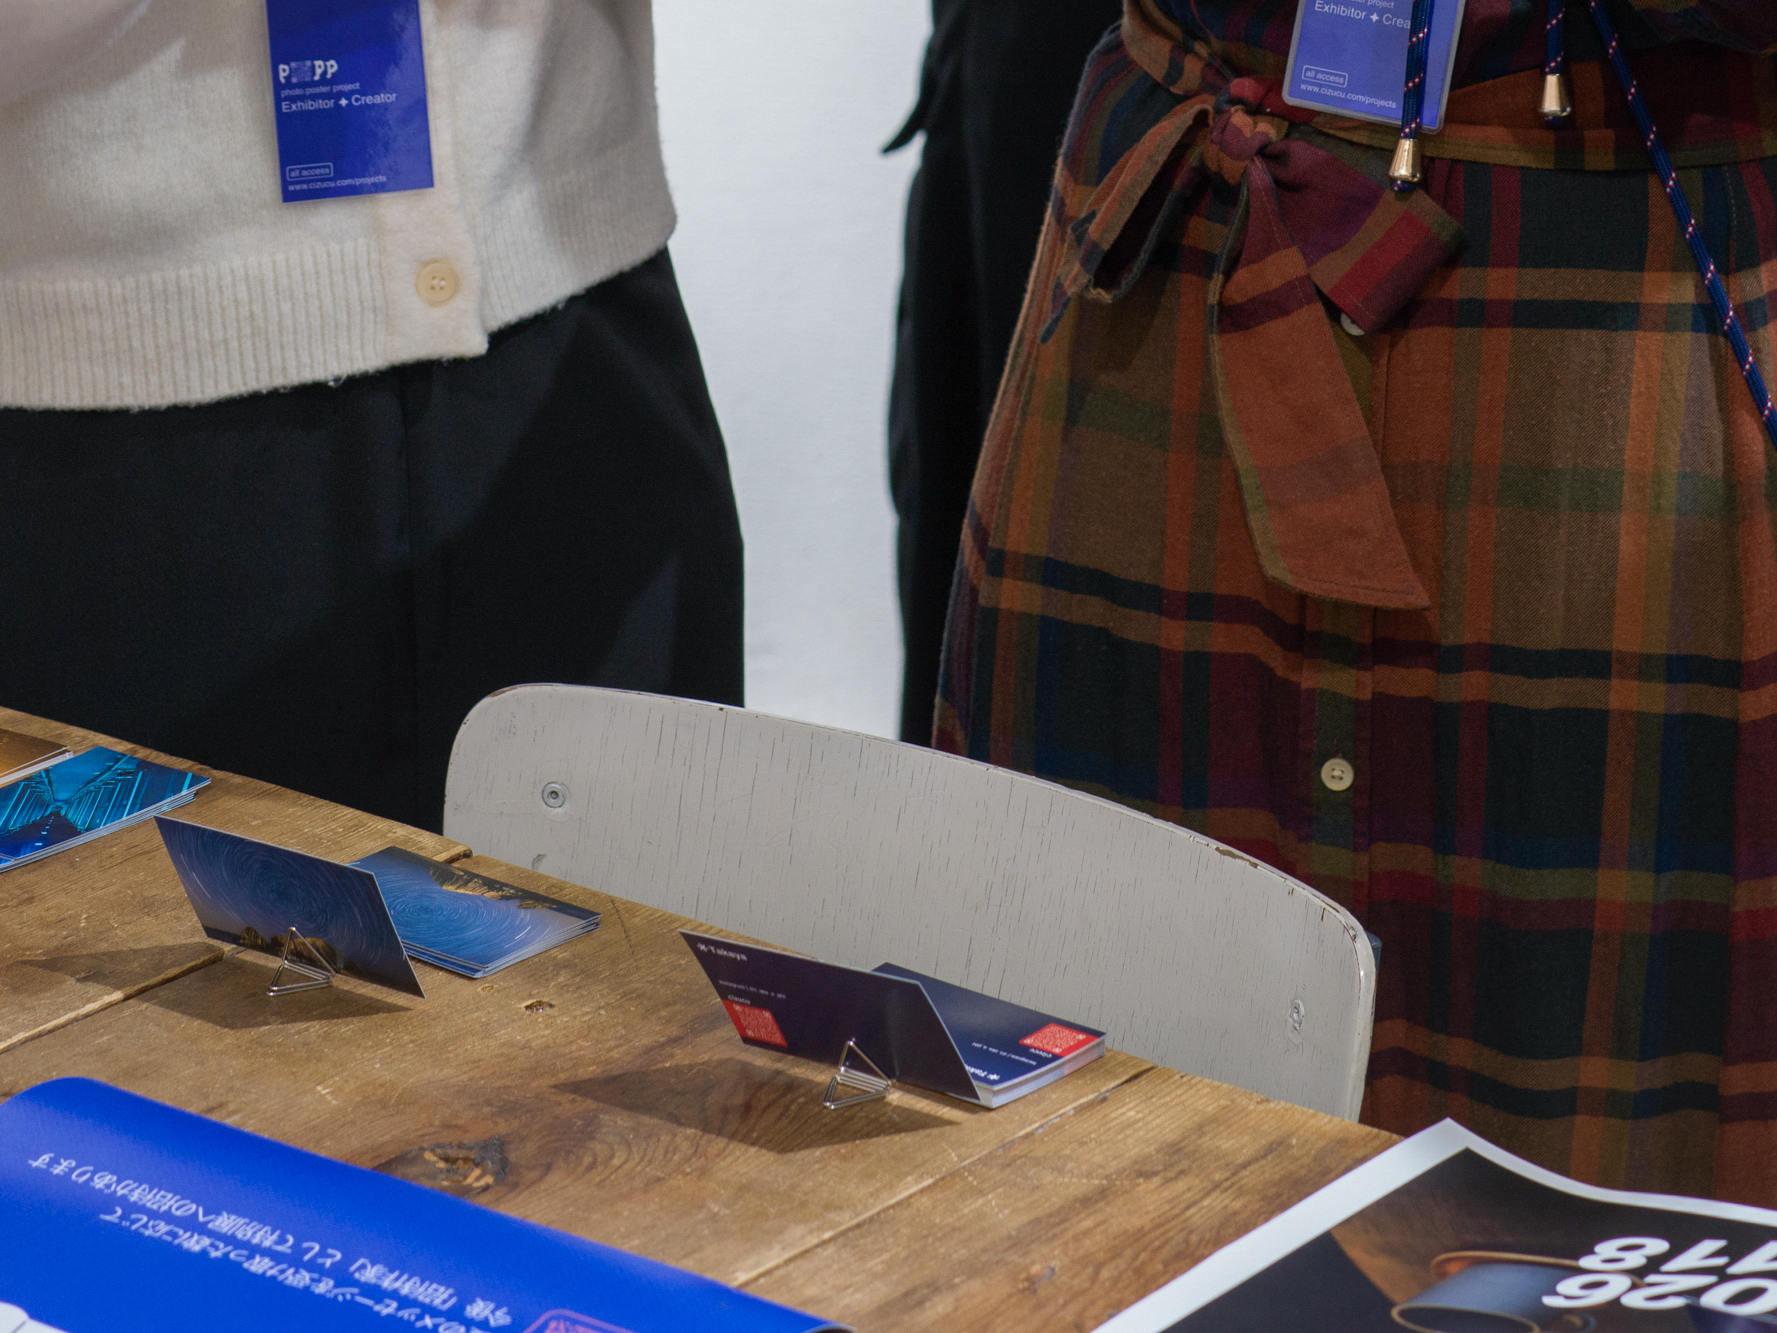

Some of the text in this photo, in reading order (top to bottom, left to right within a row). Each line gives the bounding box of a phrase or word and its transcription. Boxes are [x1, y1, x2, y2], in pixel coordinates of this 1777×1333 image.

[1314, 0, 1411, 30] Exhibitor Crea
[1305, 69, 1345, 84] all access
[281, 88, 304, 98] photo
[332, 82, 360, 93] project
[1300, 83, 1397, 108] www.cizucu.com/projects
[282, 93, 397, 112] Exhibitor Creator
[100, 1206, 497, 1333] のメッセージを受け取った数に応じて
